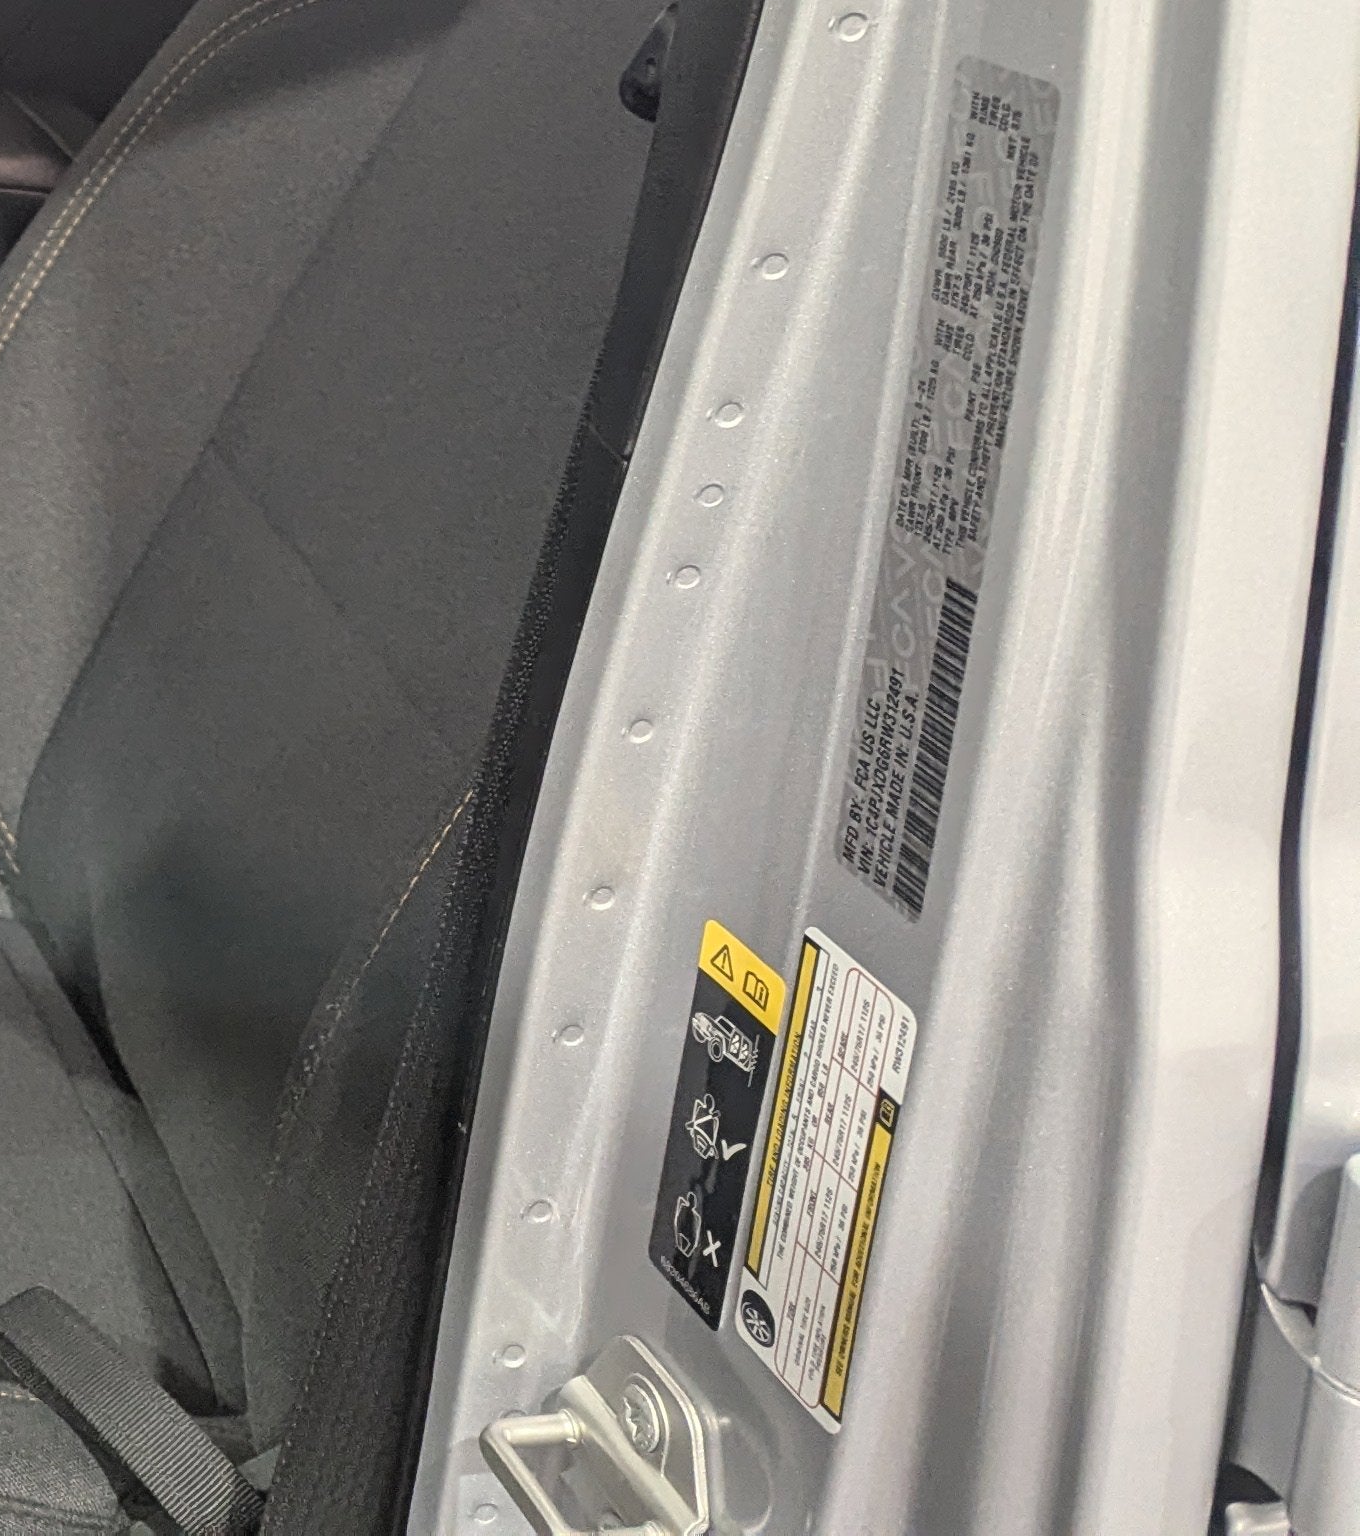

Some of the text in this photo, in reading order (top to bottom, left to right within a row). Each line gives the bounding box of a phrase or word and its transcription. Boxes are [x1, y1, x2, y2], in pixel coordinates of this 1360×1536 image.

[842, 695, 880, 864] MFD BY: FCA US LLC
[872, 686, 918, 890] VEHICLE MADE IN: U.S.A.
[857, 838, 874, 877] VIN:
[770, 1140, 780, 1165] AND
[783, 1029, 801, 1098] INFORMATION
[806, 1087, 814, 1107] AND
